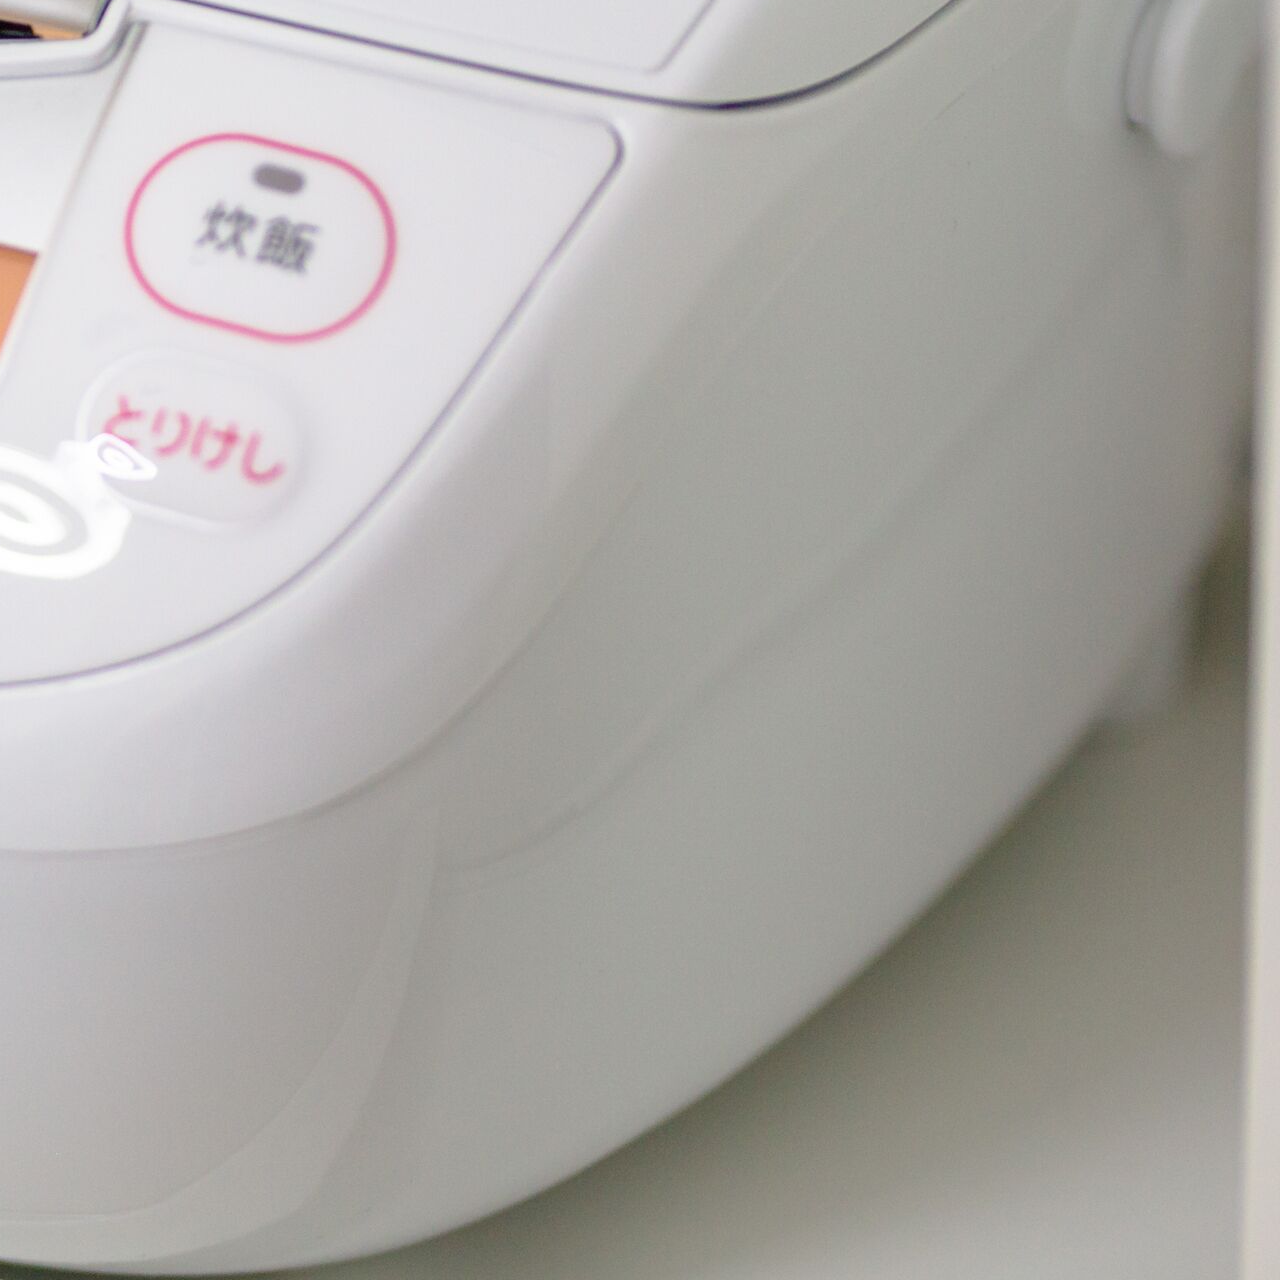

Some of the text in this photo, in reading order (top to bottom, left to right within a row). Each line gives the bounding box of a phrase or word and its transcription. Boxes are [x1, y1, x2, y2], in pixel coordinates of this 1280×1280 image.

[196, 200, 319, 274] 炊飯
[103, 395, 285, 485] とりけし
